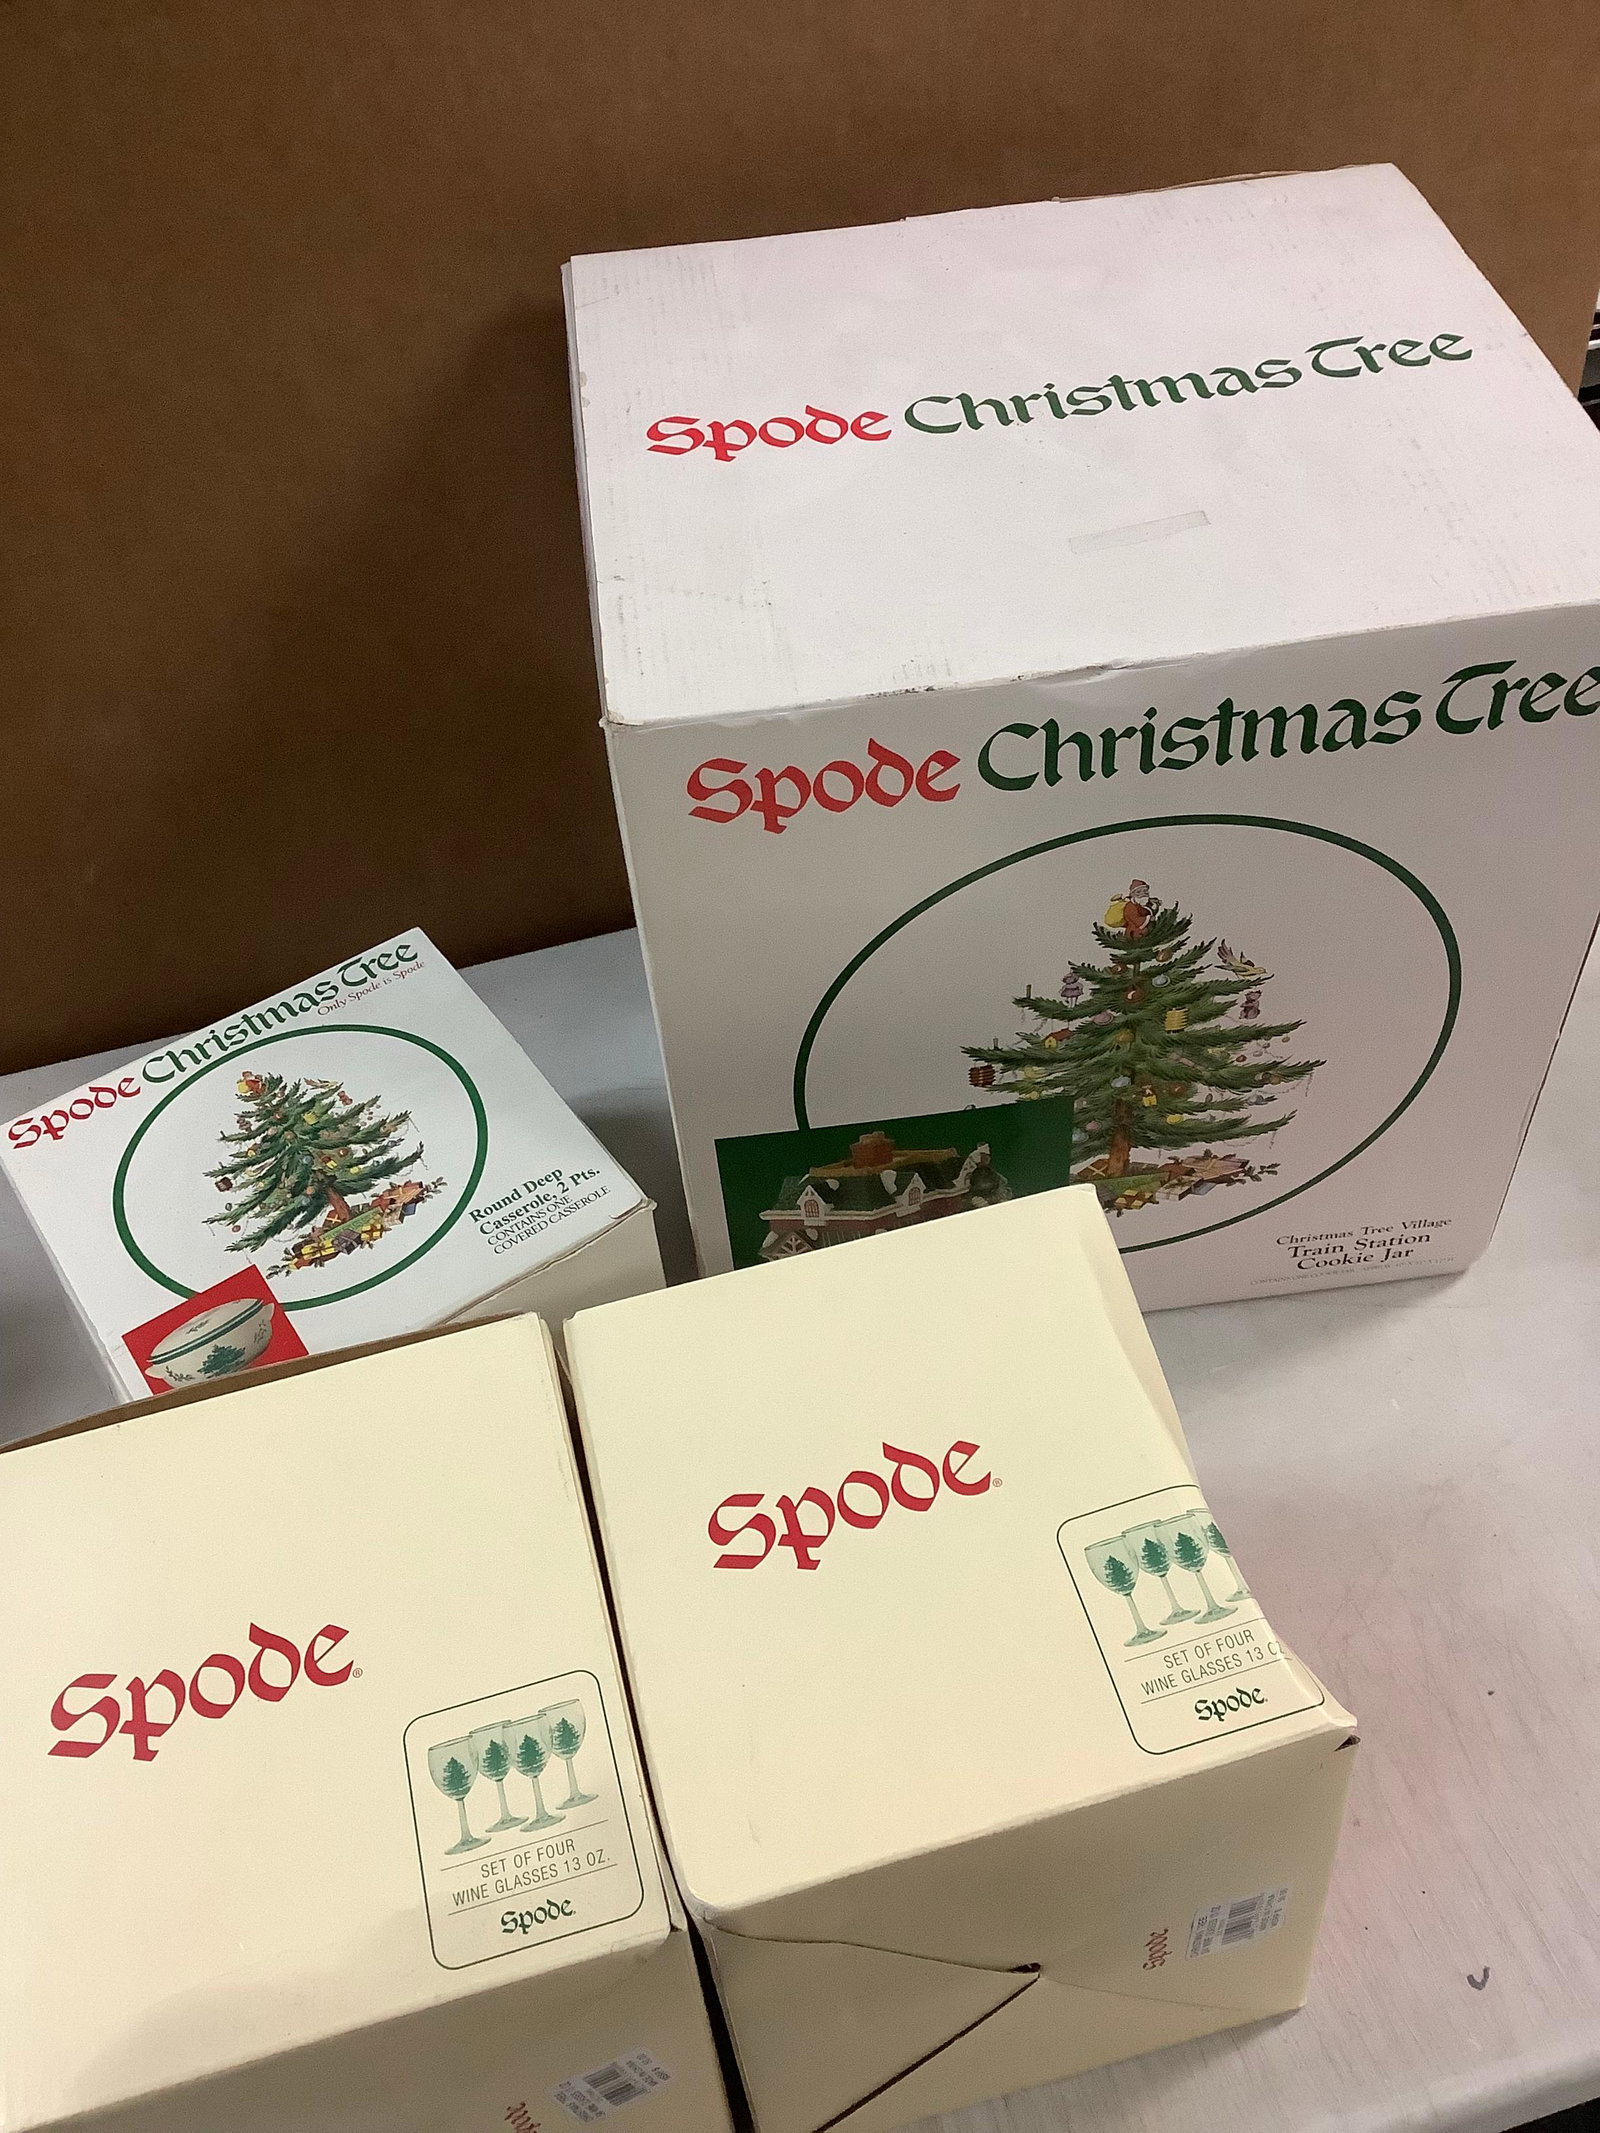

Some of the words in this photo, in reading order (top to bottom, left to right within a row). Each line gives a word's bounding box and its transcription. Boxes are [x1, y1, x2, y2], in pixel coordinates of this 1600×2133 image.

[646, 405, 892, 462] Spode
[904, 355, 1304, 435] Christmas
[1308, 332, 1474, 379] Tree
[687, 738, 961, 834] Spode
[977, 690, 1422, 792] Christmas
[1435, 659, 1600, 735] Tree
[317, 998, 347, 1015] Only
[347, 981, 381, 1001] Spode
[383, 976, 392, 985] is
[392, 960, 425, 979] Spode
[7, 1077, 141, 1149] Spode
[141, 979, 339, 1083] Christmas
[336, 944, 418, 987] Tree
[469, 1188, 522, 1223] Round
[522, 1168, 563, 1194] Deep
[480, 1191, 558, 1235] Casserole,
[556, 1181, 570, 1194] 2
[568, 1168, 600, 1186] Pts.
[487, 1209, 547, 1246] CONTAINS
[546, 1194, 573, 1213] ONE
[494, 1220, 548, 1255] COVERED
[548, 1185, 611, 1224] CASSEROLE
[1276, 1230, 1354, 1245] Christmas
[1360, 1225, 1394, 1236] Tree
[1401, 1219, 1452, 1231] Village
[1287, 1243, 1344, 1259] Train
[1354, 1233, 1431, 1251] Station
[1297, 1251, 1374, 1270] Cookie
[1380, 1248, 1414, 1263] Jar
[1141, 1674, 1178, 1695] WINE
[1181, 1653, 1243, 1684] GLASSES
[1246, 1646, 1264, 1662] 13
[1163, 1650, 1190, 1669] SET
[1194, 1642, 1212, 1658] OF
[1215, 1629, 1255, 1652] FOUR
[452, 1883, 489, 1906] WINE
[495, 1863, 559, 1894] GLASSES
[563, 1856, 581, 1873] 13
[586, 1849, 610, 1867] OZ.
[480, 1858, 507, 1878] SET
[513, 1851, 532, 1868] OF
[536, 1838, 576, 1861] FOUR
[1143, 1928, 1173, 1970] Spode
[504, 2101, 541, 2133] pode
